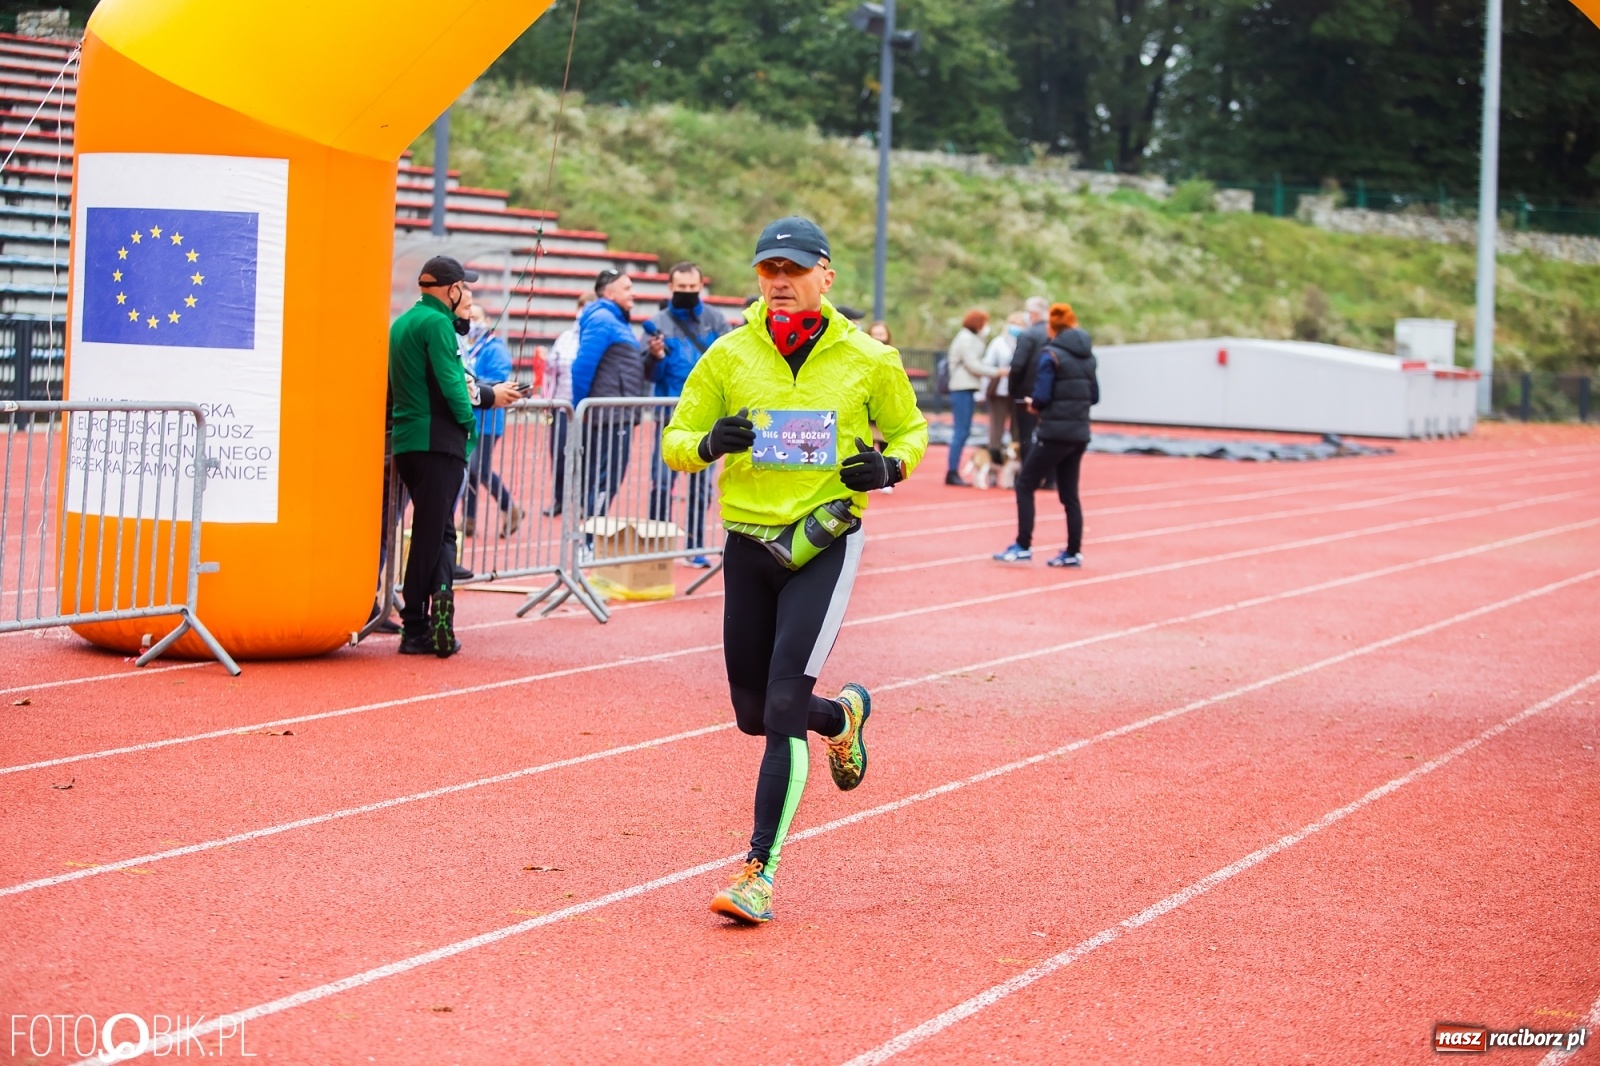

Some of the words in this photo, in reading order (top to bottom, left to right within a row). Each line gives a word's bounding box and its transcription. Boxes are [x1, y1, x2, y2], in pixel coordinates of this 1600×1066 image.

[762, 430, 779, 439] BIEG
[782, 431, 797, 440] DLA
[128, 441, 272, 461] REGIONLNEGO
[800, 451, 828, 466] 229
